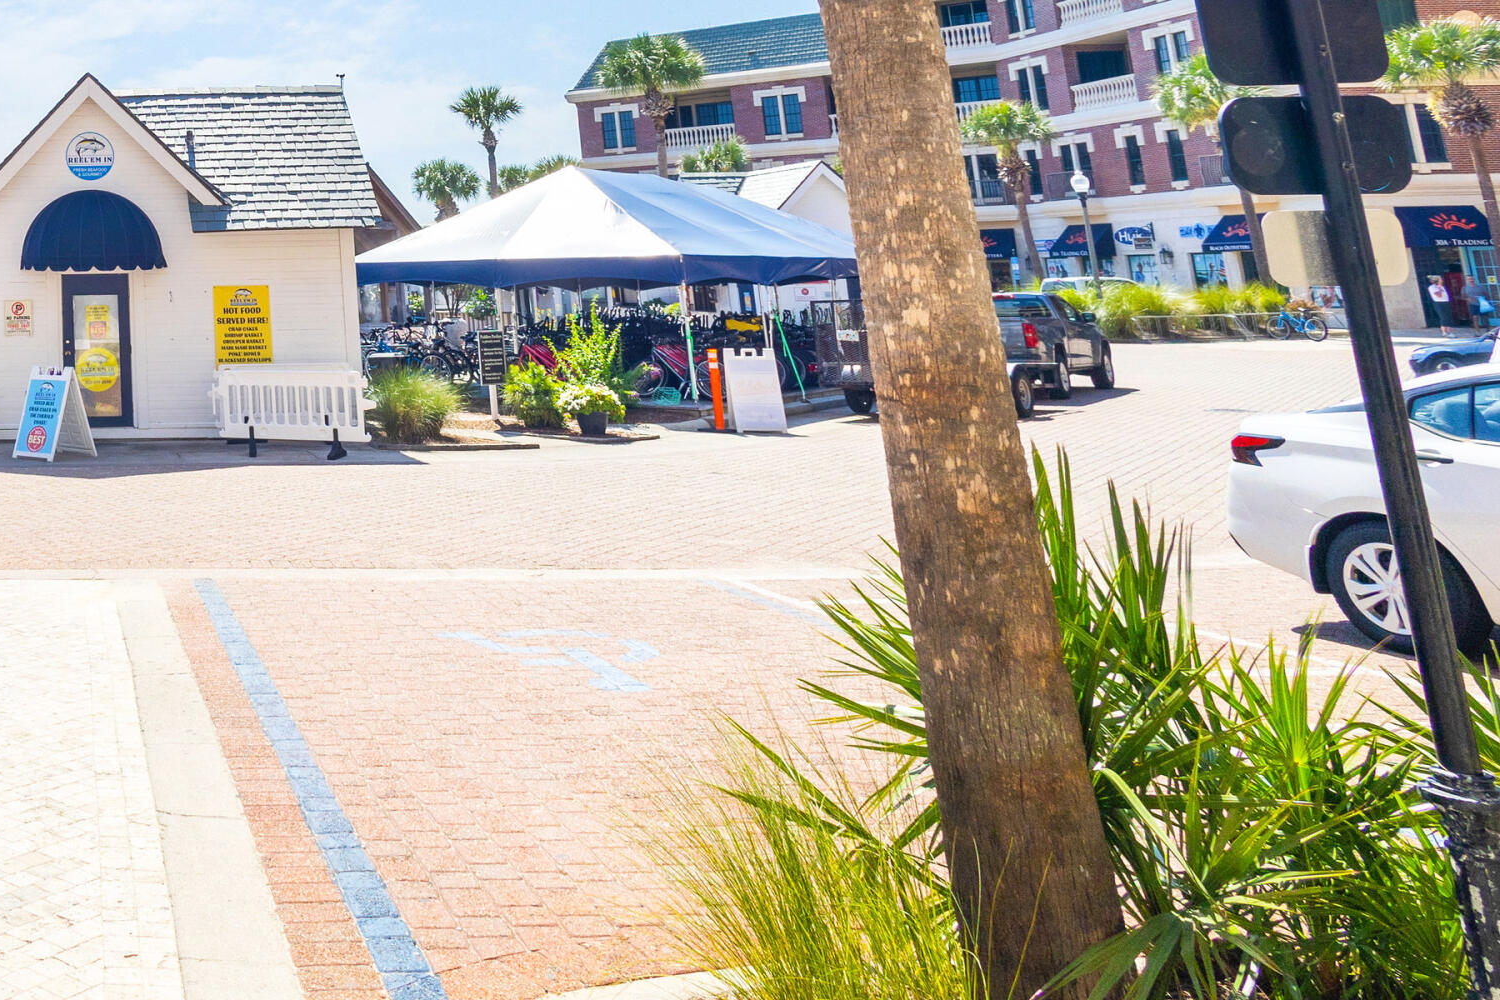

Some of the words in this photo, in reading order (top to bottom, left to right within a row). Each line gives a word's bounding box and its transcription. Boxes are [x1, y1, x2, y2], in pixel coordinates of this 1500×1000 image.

[223, 307, 238, 315] HOT
[240, 307, 261, 315] FOOD
[216, 317, 246, 325] SERVED
[247, 316, 268, 324] HERE!
[28, 434, 45, 444] BEST
